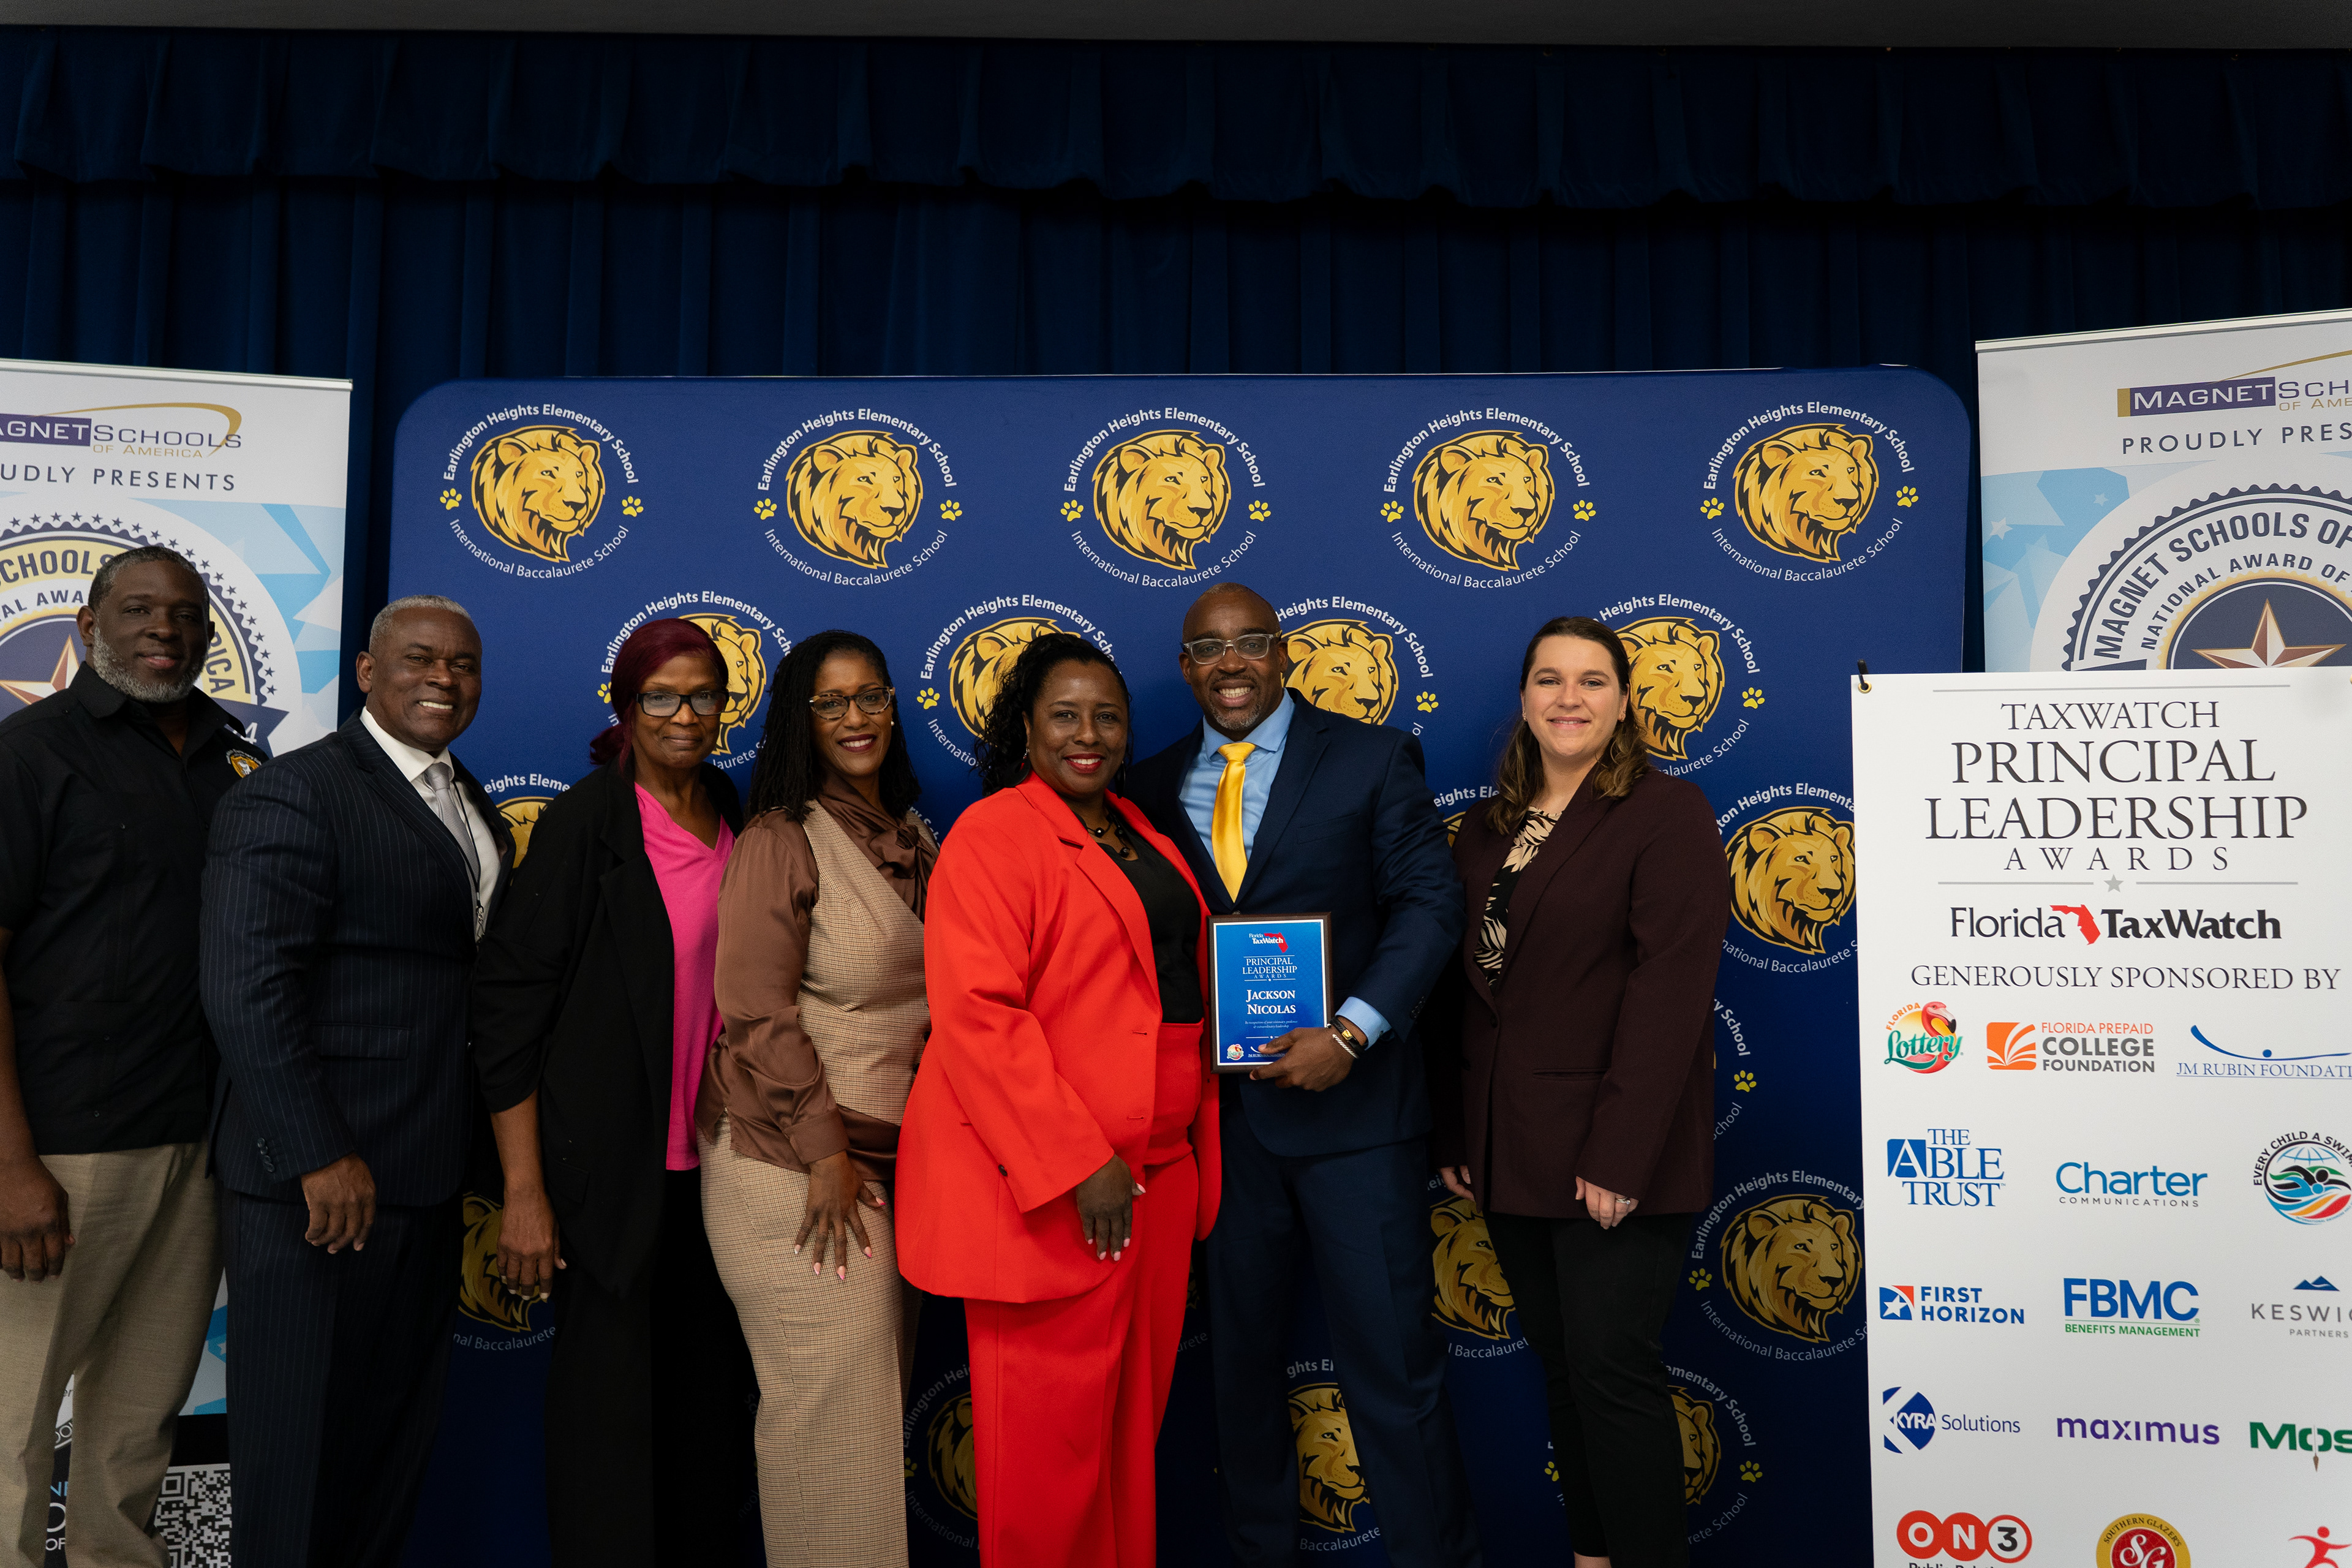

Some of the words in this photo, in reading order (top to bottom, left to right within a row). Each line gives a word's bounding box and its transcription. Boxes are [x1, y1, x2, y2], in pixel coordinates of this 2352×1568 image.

[2133, 383, 2273, 410] MAGNET
[2279, 401, 2301, 411] OF
[0, 421, 89, 440] GNET
[93, 425, 241, 448] SCHOOLS
[443, 420, 488, 480] Earlington
[486, 405, 539, 425] Heights
[543, 404, 614, 442] Elementary
[612, 439, 638, 483] School
[758, 429, 803, 491] Earlington
[802, 410, 854, 433] Heights
[858, 409, 932, 445] Elementary
[929, 443, 957, 487] School
[1064, 429, 1109, 491] Earlington
[1107, 409, 1161, 432] Heights
[1165, 408, 1240, 445] Elementary
[1237, 442, 1265, 487] School
[1384, 430, 1429, 492] Earlington
[1428, 410, 1482, 433] Heights
[1487, 408, 1563, 445] Elementary
[1560, 442, 1589, 486] School
[1704, 425, 1749, 489] Earlington
[1748, 404, 1803, 429] Heights
[1807, 402, 1888, 434] Elementary
[1885, 429, 1914, 472] School
[2122, 429, 2263, 454] PROUDLY
[2282, 422, 2352, 443] PRES
[93, 445, 114, 453] OF
[123, 445, 202, 458] AMERICA
[0, 464, 75, 483] UDLY
[94, 469, 235, 491] PRESENTS
[450, 519, 514, 574] International
[517, 557, 595, 578] Baccalaurete
[594, 525, 629, 562] School
[765, 529, 832, 582] International
[834, 564, 913, 586] Baccalaurete
[913, 530, 948, 567] School
[1071, 531, 1139, 584] International
[1142, 565, 1221, 587] Baccalaurete
[1221, 531, 1256, 568] School
[1392, 532, 1461, 585] International
[1464, 566, 1545, 588] Baccalaurete
[1545, 530, 1581, 568] School
[1712, 528, 1782, 579] International
[1785, 554, 1866, 581] Baccalaurete
[1866, 518, 1903, 558] School
[37, 590, 84, 606] AWA
[2093, 552, 2169, 659] MAGNET
[2169, 511, 2309, 562] SCHOOLS
[2140, 567, 2222, 650] NATIONAL
[2230, 552, 2313, 572] AWARD
[2321, 564, 2351, 583] OF
[601, 611, 646, 674] Earlington
[646, 592, 698, 615] Heights
[702, 591, 775, 630] Elementary
[921, 616, 966, 679] Earlington
[965, 597, 1018, 620] Heights
[1022, 595, 1096, 633] Elementary
[1276, 598, 1329, 622] Heights
[1332, 597, 1408, 635] Elementary
[1404, 632, 1433, 677] School
[1599, 596, 1655, 622] Heights
[1659, 594, 1735, 631] Elementary
[1732, 628, 1760, 674] School
[2001, 701, 2220, 729] TAXWATCH
[928, 718, 976, 766] Internatio
[1713, 719, 1749, 758] School
[1951, 739, 2275, 783] PRINCIPAL
[484, 775, 526, 793] eights
[529, 774, 570, 792] Eleme
[1433, 788, 1476, 807] eights
[1737, 785, 1792, 810] Heights
[1925, 796, 2307, 839] LEADERSHIP
[2004, 847, 2228, 870] AWARDS
[1950, 907, 2066, 938] Florida
[2101, 909, 2282, 939] TaxWatch
[1242, 966, 1297, 974] LEADERSHIP
[1722, 938, 1768, 970] national
[1771, 949, 1851, 973] Baccalaurete
[1911, 965, 2103, 987] GENEROUSLY
[2111, 967, 2293, 989] SPONSORED
[2304, 968, 2341, 989] BY
[1721, 1009, 1751, 1056] School
[1885, 1002, 1920, 1031] FLORIDA
[2041, 1022, 2096, 1033] FLORIDA
[2099, 1023, 2154, 1034] PREPAID
[1884, 1030, 1963, 1069] Lottery
[2043, 1036, 2154, 1057] COLLEGE
[2043, 1059, 2155, 1072] FOUNDATION
[2177, 1063, 2198, 1075] JM
[2203, 1063, 2255, 1076] RUBIN
[2260, 1064, 2352, 1077] FOUNDATI
[1928, 1129, 1970, 1145] THE
[1887, 1139, 2005, 1180] ABLE
[2253, 1148, 2272, 1186] EVERY
[2271, 1131, 2308, 1149] CHILD
[2312, 1133, 2320, 1141] A
[1902, 1181, 2000, 1207] TRUST
[2056, 1162, 2208, 1196] Charter
[1692, 1193, 1736, 1259] Earlington
[1735, 1172, 1789, 1196] Heights
[1792, 1170, 1864, 1210] Elementary
[2059, 1197, 2199, 1207] COMMUNICATIONS
[1921, 1286, 1982, 1303] FIRST
[2064, 1278, 2199, 1321] FBMC
[1921, 1306, 2024, 1324] HORIZON
[2252, 1303, 2352, 1323] KESWI
[475, 1327, 556, 1350] Baccalaurete
[1701, 1300, 1772, 1357] International
[1776, 1337, 1856, 1360] Baccalaurete
[2065, 1324, 2116, 1335] BENEFITS
[2119, 1325, 2200, 1337] MANAGEMENT
[2290, 1329, 2349, 1338] PARTNERS
[1455, 1336, 1529, 1358] Baccalauret
[1666, 1365, 1728, 1401] ementary
[1725, 1399, 1757, 1446] School
[1896, 1412, 1936, 1429] KYRA
[1942, 1414, 2021, 1433] Solutions
[2057, 1417, 2220, 1445] maximus
[1713, 1493, 1748, 1531] School
[2103, 1517, 2144, 1544] SOUTHERN
[2146, 1518, 2182, 1547] GLAZER'S
